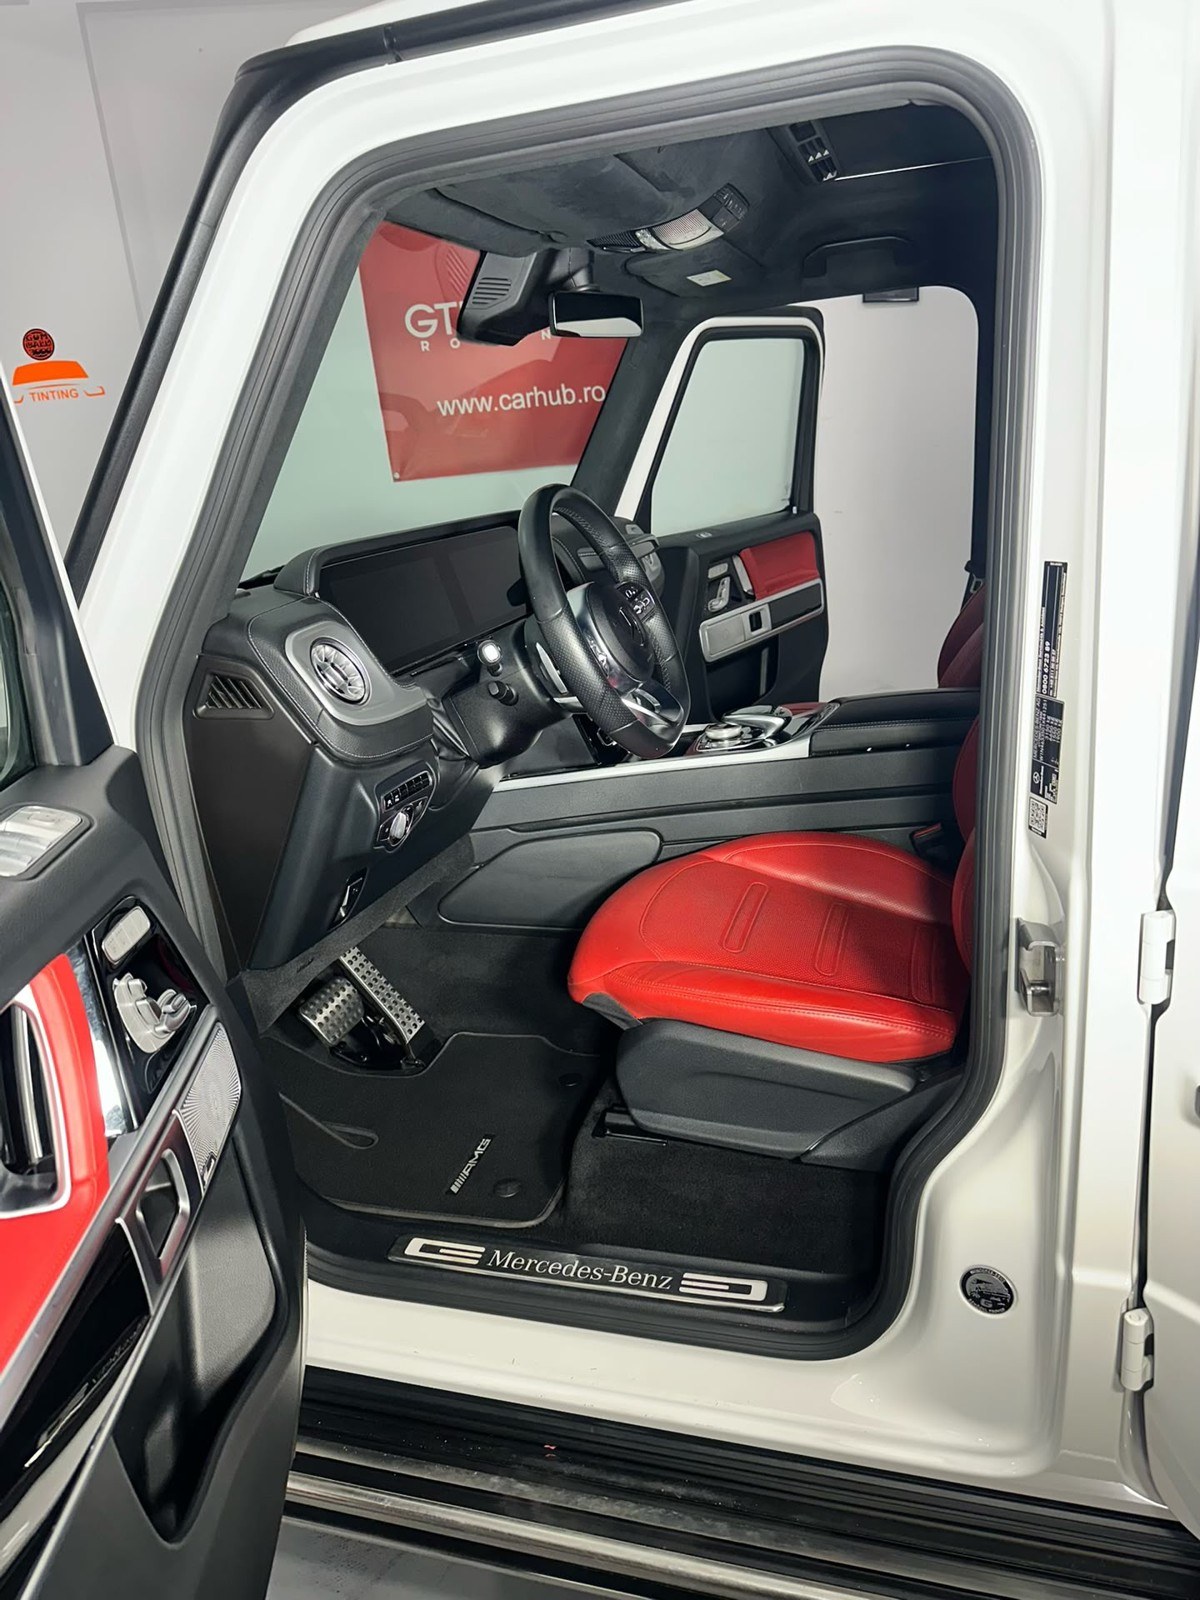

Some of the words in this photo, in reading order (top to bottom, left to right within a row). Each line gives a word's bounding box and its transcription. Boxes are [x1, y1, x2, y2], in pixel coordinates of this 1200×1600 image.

[405, 301, 463, 338] GT
[29, 388, 79, 402] TINTING
[437, 383, 606, 417] www.carhub.ro
[487, 1249, 673, 1290] Mercedes-Benz
